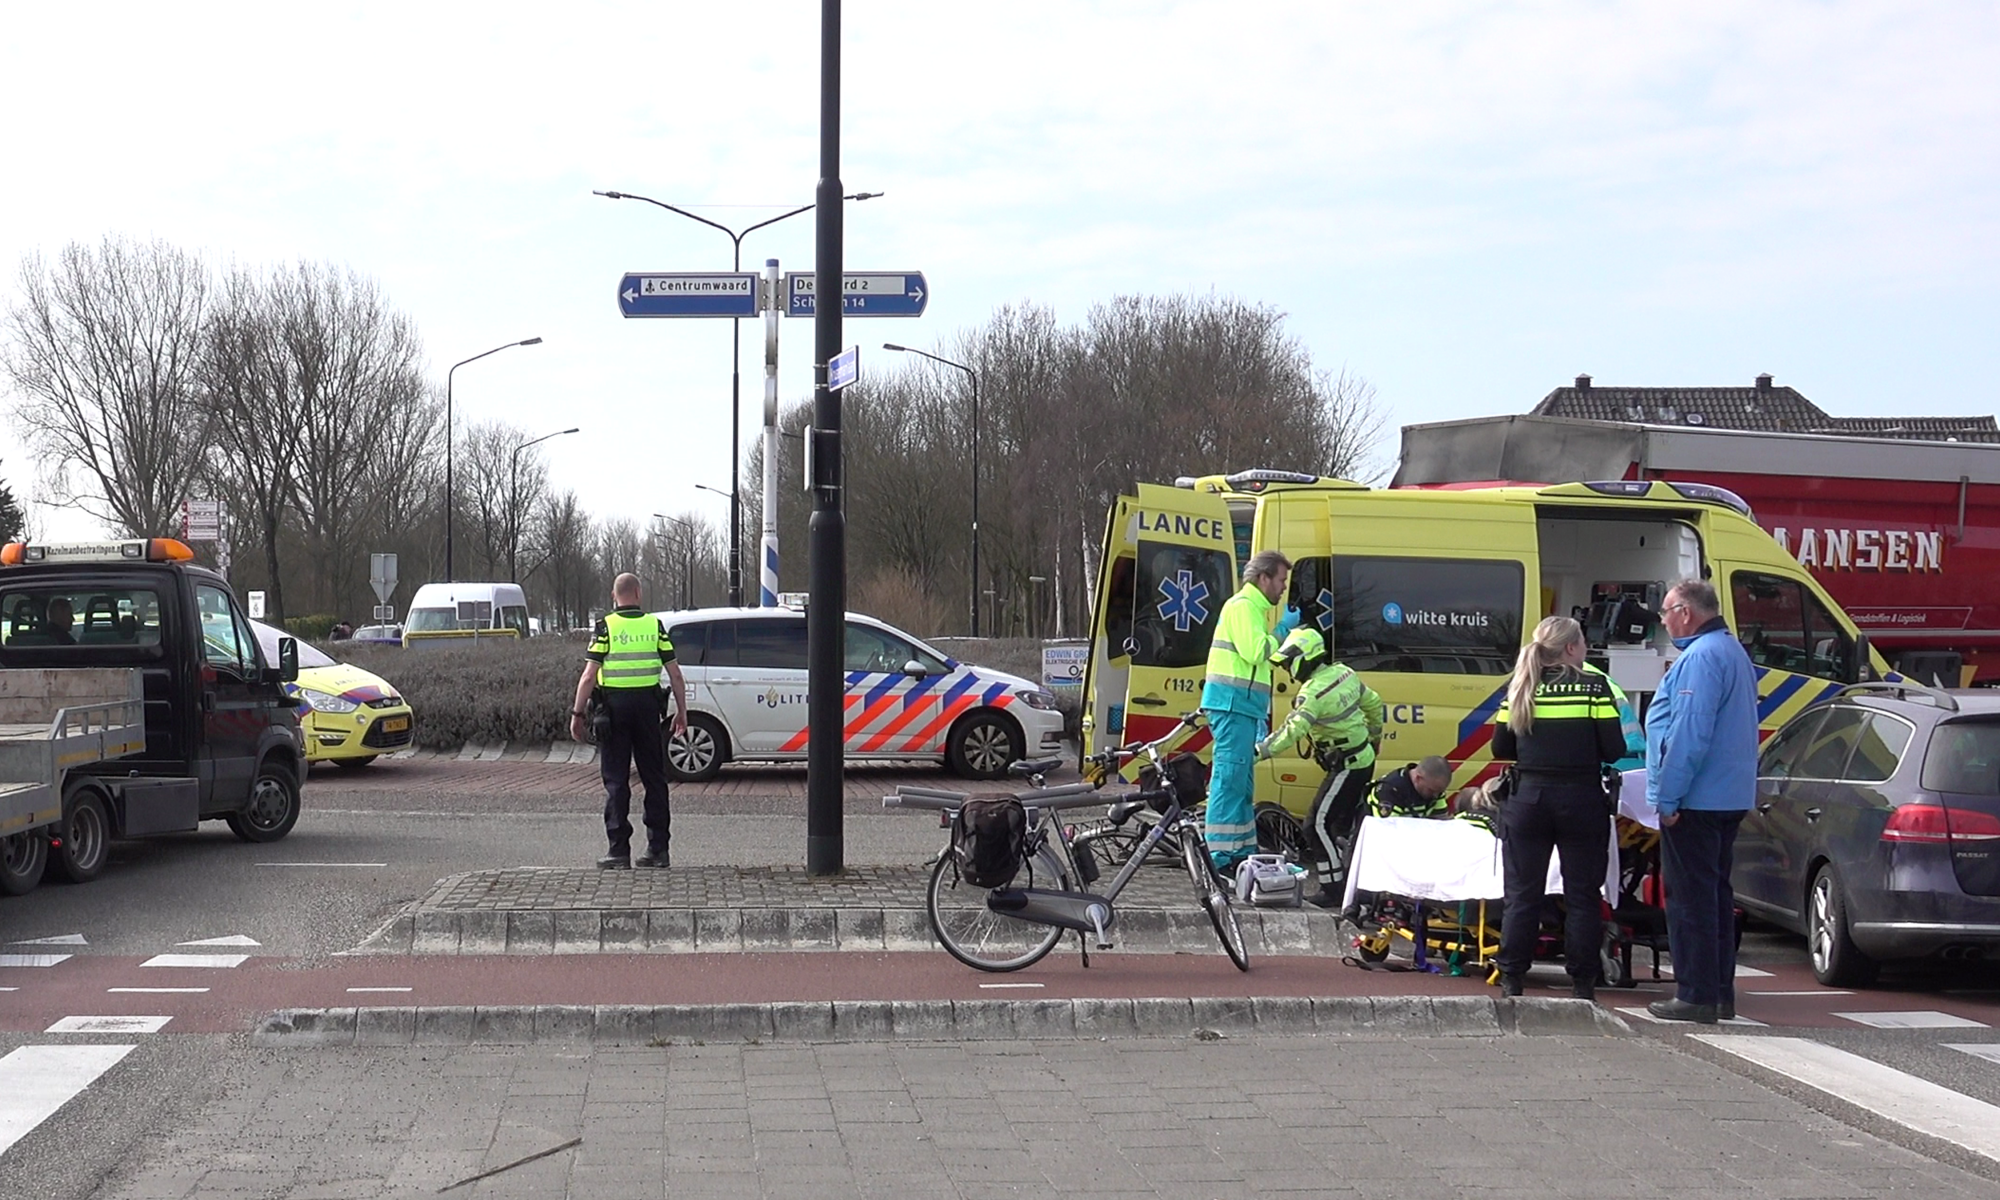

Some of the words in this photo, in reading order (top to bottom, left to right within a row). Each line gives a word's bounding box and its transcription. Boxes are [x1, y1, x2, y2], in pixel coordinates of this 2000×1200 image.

[659, 280, 748, 291] Centrumwaard
[797, 279, 814, 290] De
[861, 280, 869, 290] 2
[852, 297, 865, 307] 14
[1405, 610, 1447, 625] witte
[1450, 611, 1489, 626] kruis
[613, 633, 656, 645] POLITIE
[1046, 650, 1072, 658] EDWIN
[757, 692, 809, 709] POLITI
